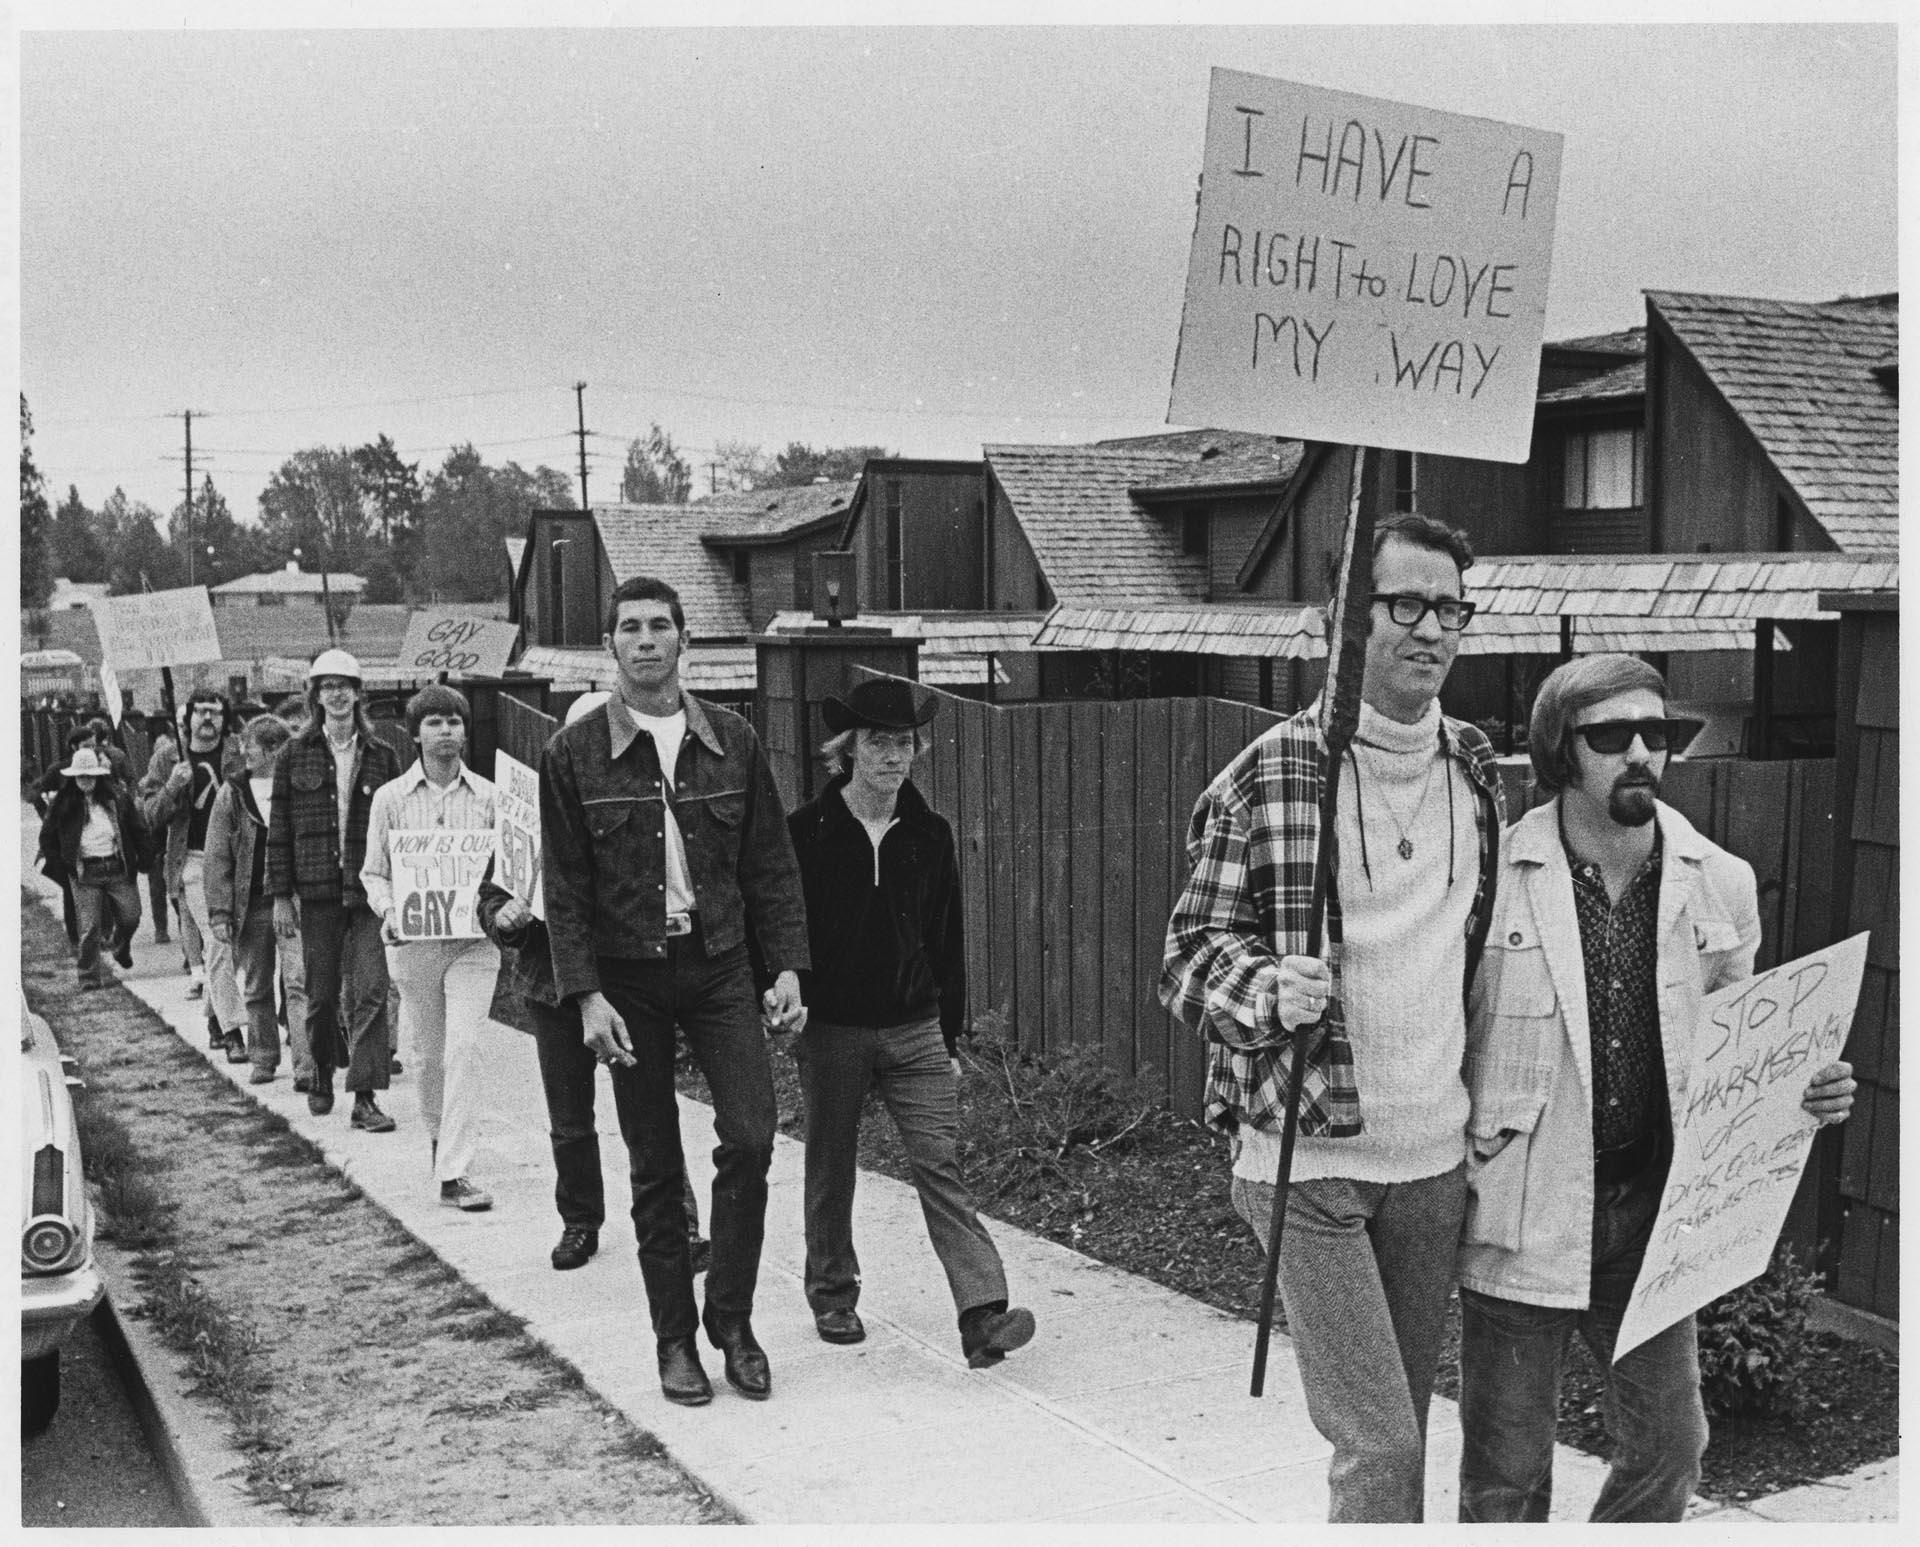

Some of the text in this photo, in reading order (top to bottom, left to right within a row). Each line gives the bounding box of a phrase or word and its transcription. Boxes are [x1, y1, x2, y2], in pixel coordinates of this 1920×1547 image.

[1231, 105, 1534, 220] I HAVE A
[1218, 222, 1520, 320] RIGHT to LOVE
[1252, 311, 1502, 400] MY WAY
[414, 648, 480, 671] GOOD
[427, 618, 485, 645] GAY
[392, 833, 435, 854] NOW
[434, 834, 455, 854] IS
[400, 854, 490, 890] TIM
[401, 889, 457, 937] GAY
[1705, 962, 1829, 1063] STOP
[1701, 1096, 1765, 1162] OF
